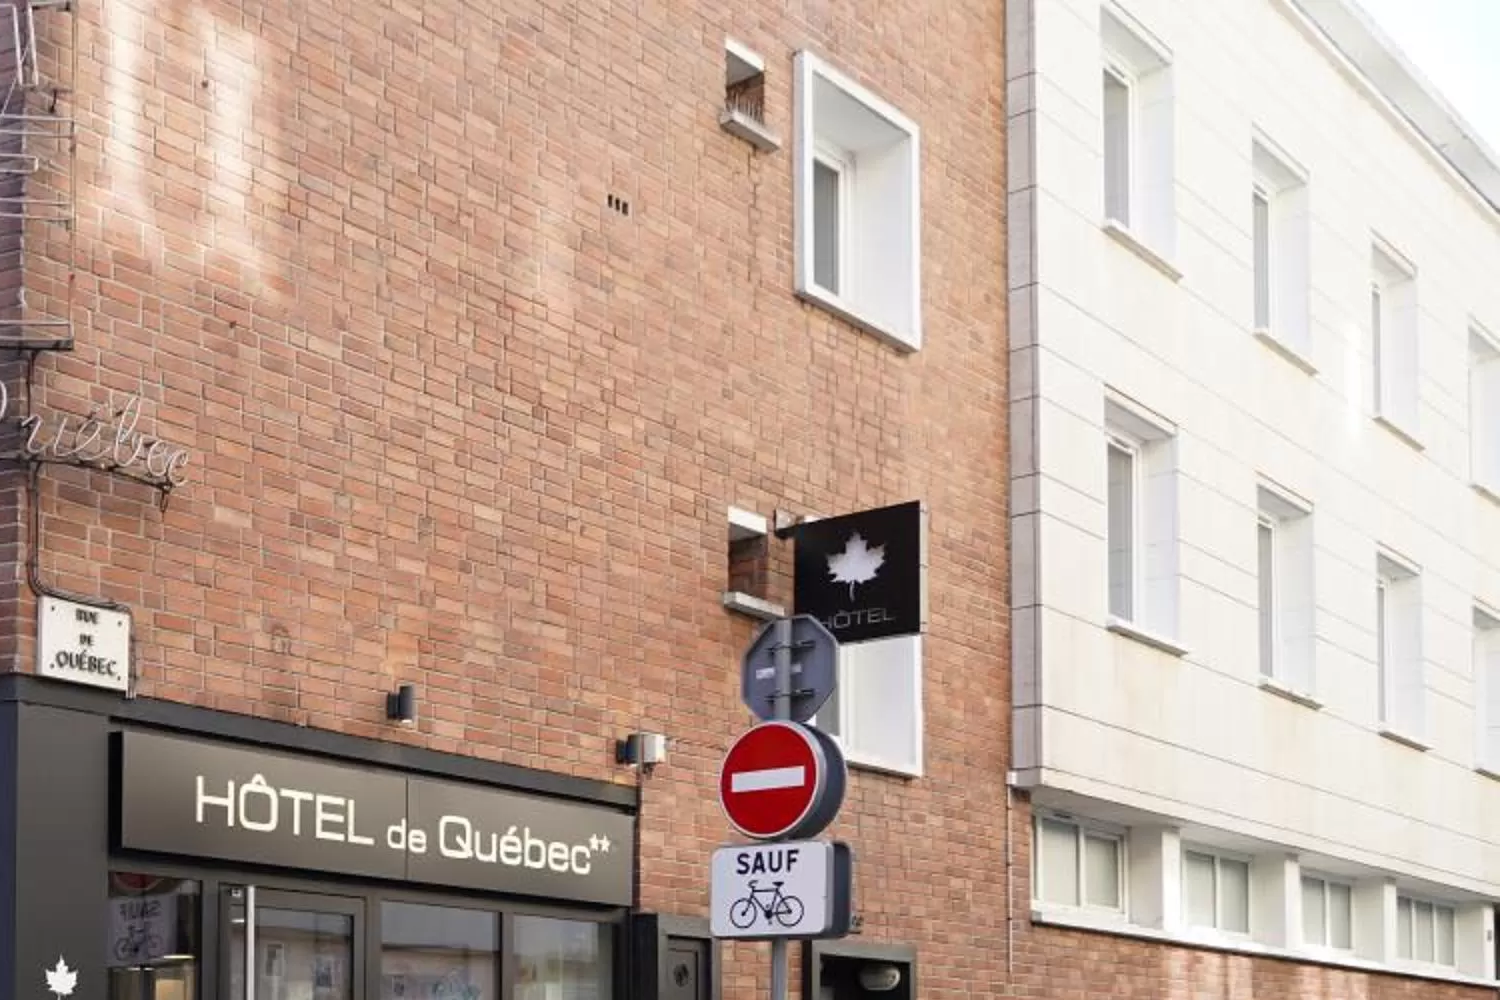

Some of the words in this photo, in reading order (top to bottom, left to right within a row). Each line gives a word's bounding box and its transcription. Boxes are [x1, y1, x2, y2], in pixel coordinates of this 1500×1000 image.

[75, 608, 100, 625] RUE
[79, 633, 96, 647] DE
[56, 649, 118, 677] QUÉBEC
[196, 773, 374, 846] HÔTEL
[387, 818, 427, 854] de
[438, 815, 592, 875] Québec
[736, 849, 800, 876] SAUF
